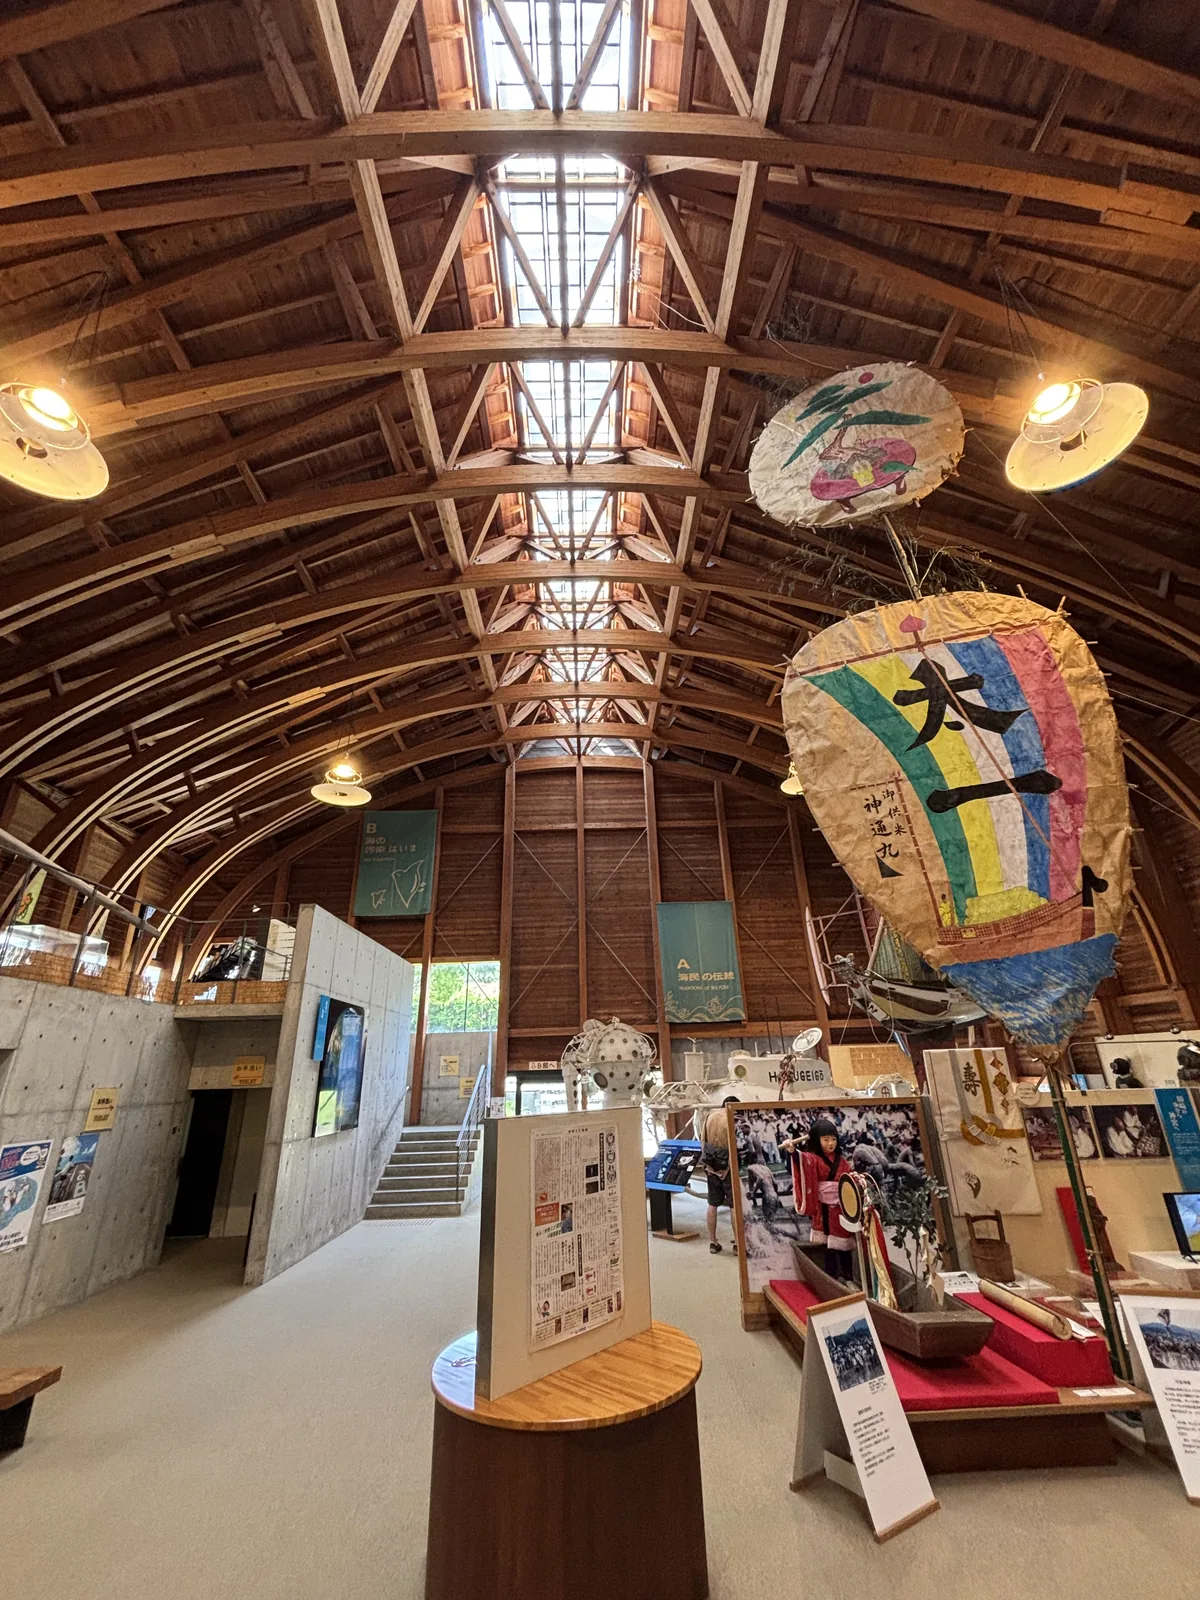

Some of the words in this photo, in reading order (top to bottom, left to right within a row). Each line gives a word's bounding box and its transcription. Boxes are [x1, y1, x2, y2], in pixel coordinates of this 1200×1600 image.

[893, 658, 1063, 814] 太一
[366, 822, 377, 834] B
[863, 794, 900, 859] 神通丸
[677, 958, 691, 969] A
